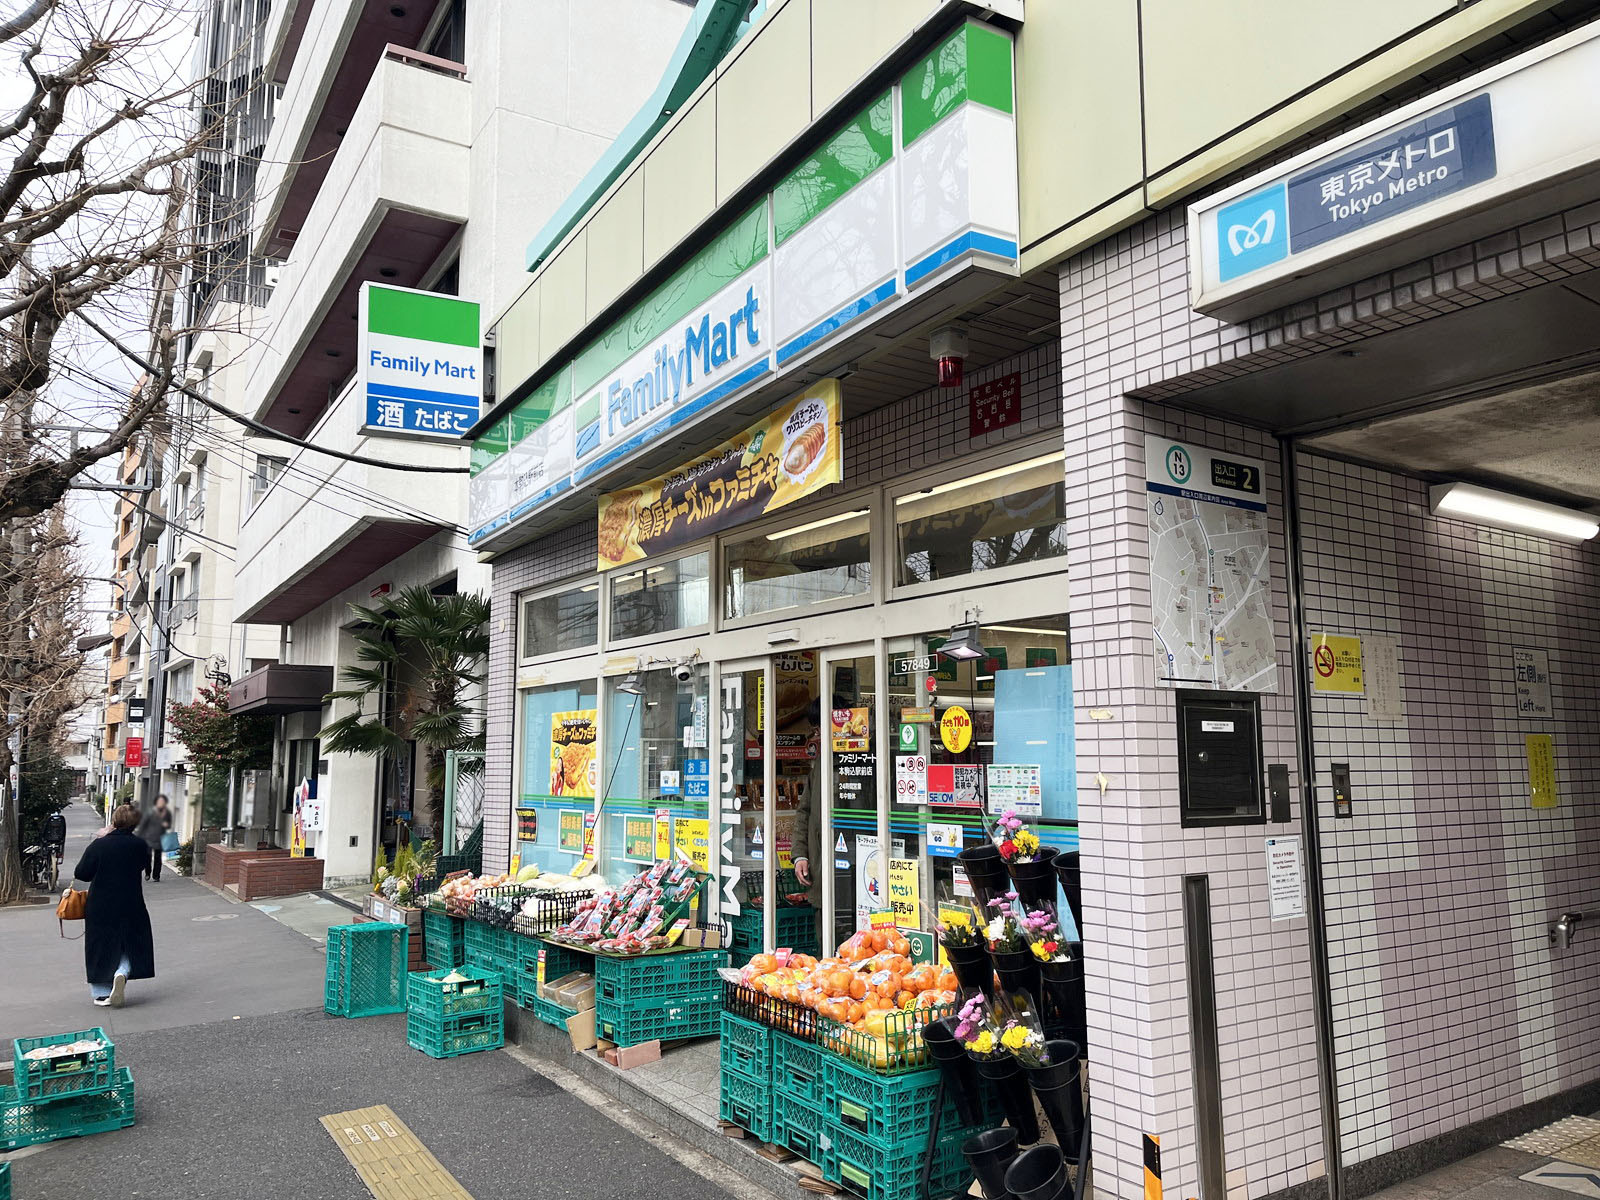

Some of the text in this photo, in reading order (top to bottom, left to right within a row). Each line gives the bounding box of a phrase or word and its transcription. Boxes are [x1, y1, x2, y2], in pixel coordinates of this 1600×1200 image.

[1319, 127, 1455, 206] 東京メトロ
[1328, 164, 1449, 224] Tokyo Metro
[370, 350, 476, 379] Family Mart
[607, 284, 761, 438] FamilyMart
[975, 386, 1015, 407] Security Bell
[376, 399, 469, 432] 酒 たばこ
[1174, 451, 1183, 463] N
[1173, 463, 1185, 476] 13
[1214, 463, 1253, 490] 出入口 2
[1215, 476, 1237, 487] Entrance
[637, 453, 780, 543] 濃厚チーズinファミチキ
[1515, 652, 1534, 661] ここでは
[901, 657, 930, 672] 57849
[1518, 686, 1530, 696] Keep
[1519, 698, 1535, 712] Left
[838, 753, 877, 763] ファミリーマート
[838, 766, 873, 776] 本駒込駅前店
[687, 782, 707, 795] たばこ
[929, 792, 954, 803] SECOM
[890, 860, 913, 871] 店内にて
[891, 883, 913, 896] やさい
[891, 900, 914, 915] 販売中
